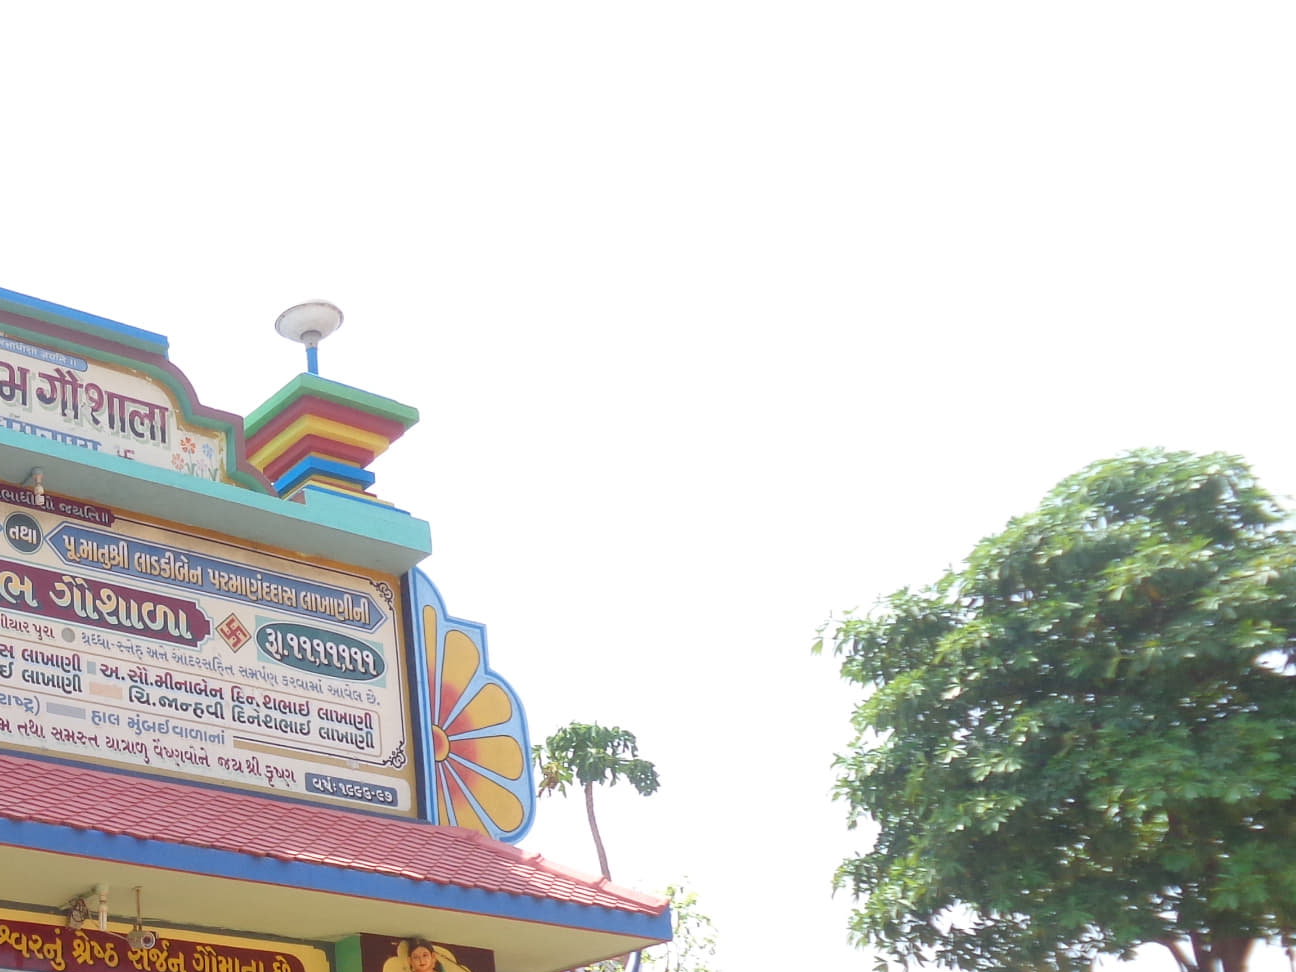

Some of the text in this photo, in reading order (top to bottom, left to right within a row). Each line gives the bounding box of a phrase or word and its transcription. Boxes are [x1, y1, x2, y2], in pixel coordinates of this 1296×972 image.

[36, 367, 169, 444] गौशाला
[8, 525, 38, 545] તથા
[134, 551, 203, 586] લાડકીબેન
[208, 568, 297, 609] પરમાણંદદાસ
[300, 590, 370, 625] લાખાણીની
[49, 576, 193, 640] ગૌશાળા
[32, 624, 55, 640] પુરા
[21, 647, 83, 674] લાખાણી
[21, 668, 83, 694] લાખાણી
[281, 680, 324, 694] કરવામાં
[91, 709, 120, 726] હાલ
[231, 686, 310, 717] દિનશભાઈ
[318, 708, 373, 731] લાખાણી
[232, 705, 311, 736] દિનેશભાઈ
[319, 726, 375, 750] લાખાણી
[17, 719, 46, 740] તથા
[50, 726, 101, 747] સમસ્ત
[105, 735, 150, 764] યાત્રાળુ
[153, 739, 211, 768] વૈષ્ણવોને
[217, 755, 244, 773] જય
[245, 756, 262, 777] શ્રી
[264, 763, 297, 788] કૃષ્ણ
[71, 931, 120, 968] શ્રેષ્ઠ
